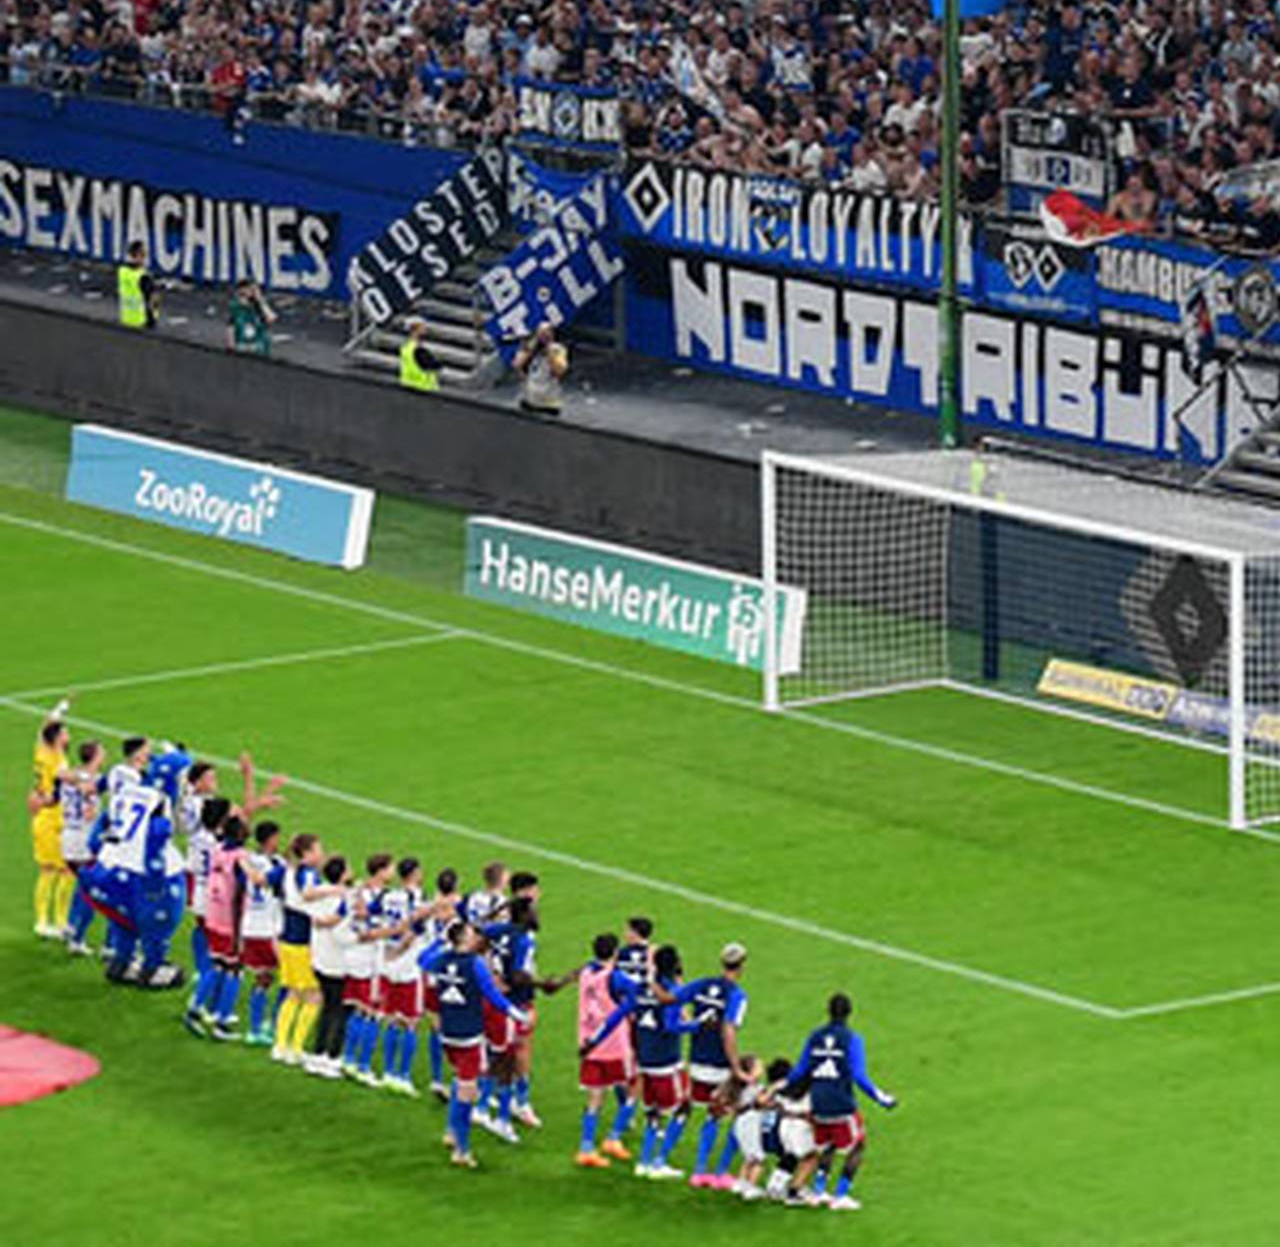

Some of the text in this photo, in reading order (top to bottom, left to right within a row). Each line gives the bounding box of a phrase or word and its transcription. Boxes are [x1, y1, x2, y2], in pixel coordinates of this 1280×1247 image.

[673, 167, 750, 253] IRON
[790, 190, 941, 279] LOYALTY
[134, 467, 267, 538] ZooRoyal
[478, 538, 721, 641] HanseMerkur
